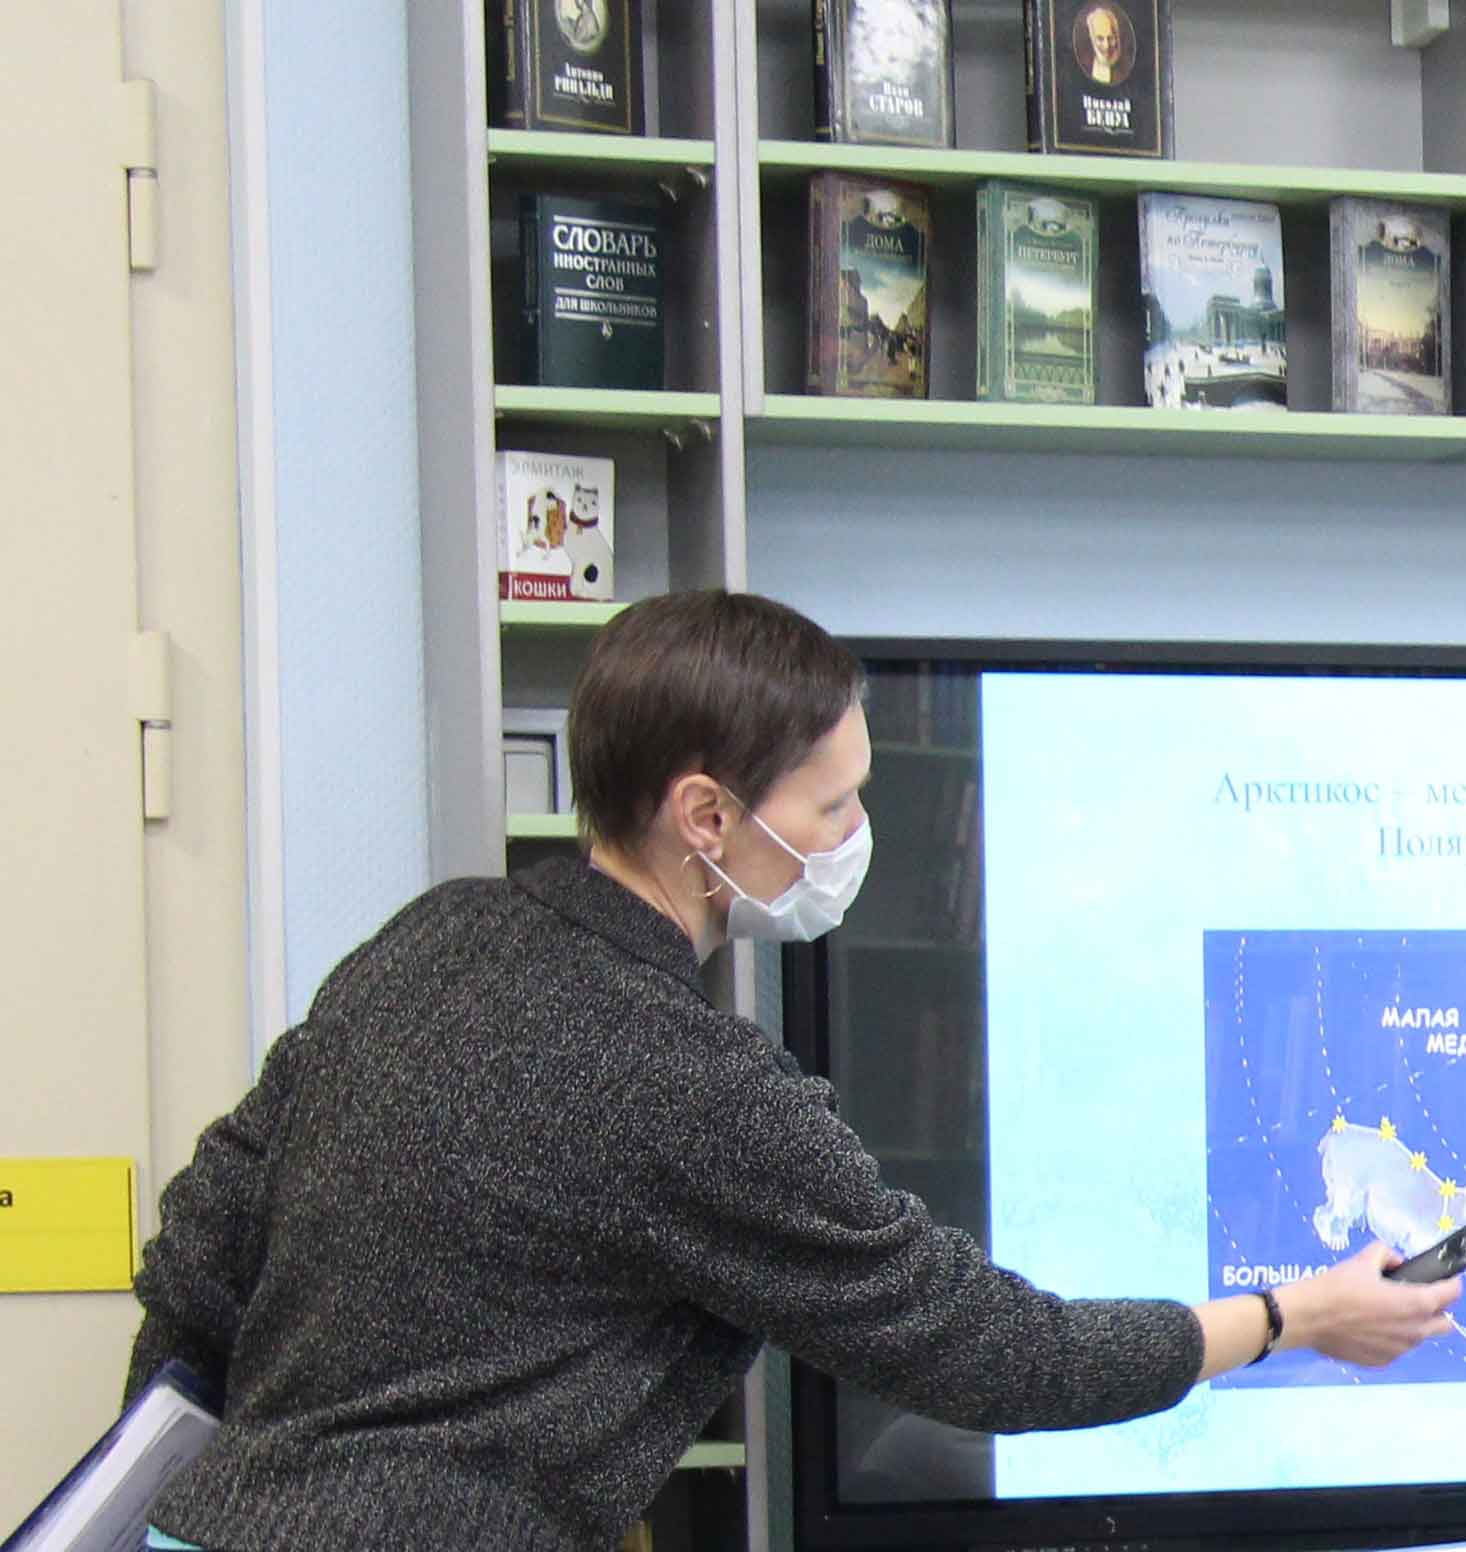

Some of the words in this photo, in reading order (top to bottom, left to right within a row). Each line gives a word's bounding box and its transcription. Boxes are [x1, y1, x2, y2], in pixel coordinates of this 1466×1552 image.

[868, 95, 924, 117] СТАРОВ
[553, 223, 657, 259] СЛОВАРЬ
[553, 252, 656, 278] ИНОСТРАННЫХ
[585, 274, 624, 292] СЛОВ
[513, 579, 568, 599] КОШКИ
[1212, 771, 1382, 813] Арктикос
[1381, 1006, 1460, 1028] МАЛАЯ
